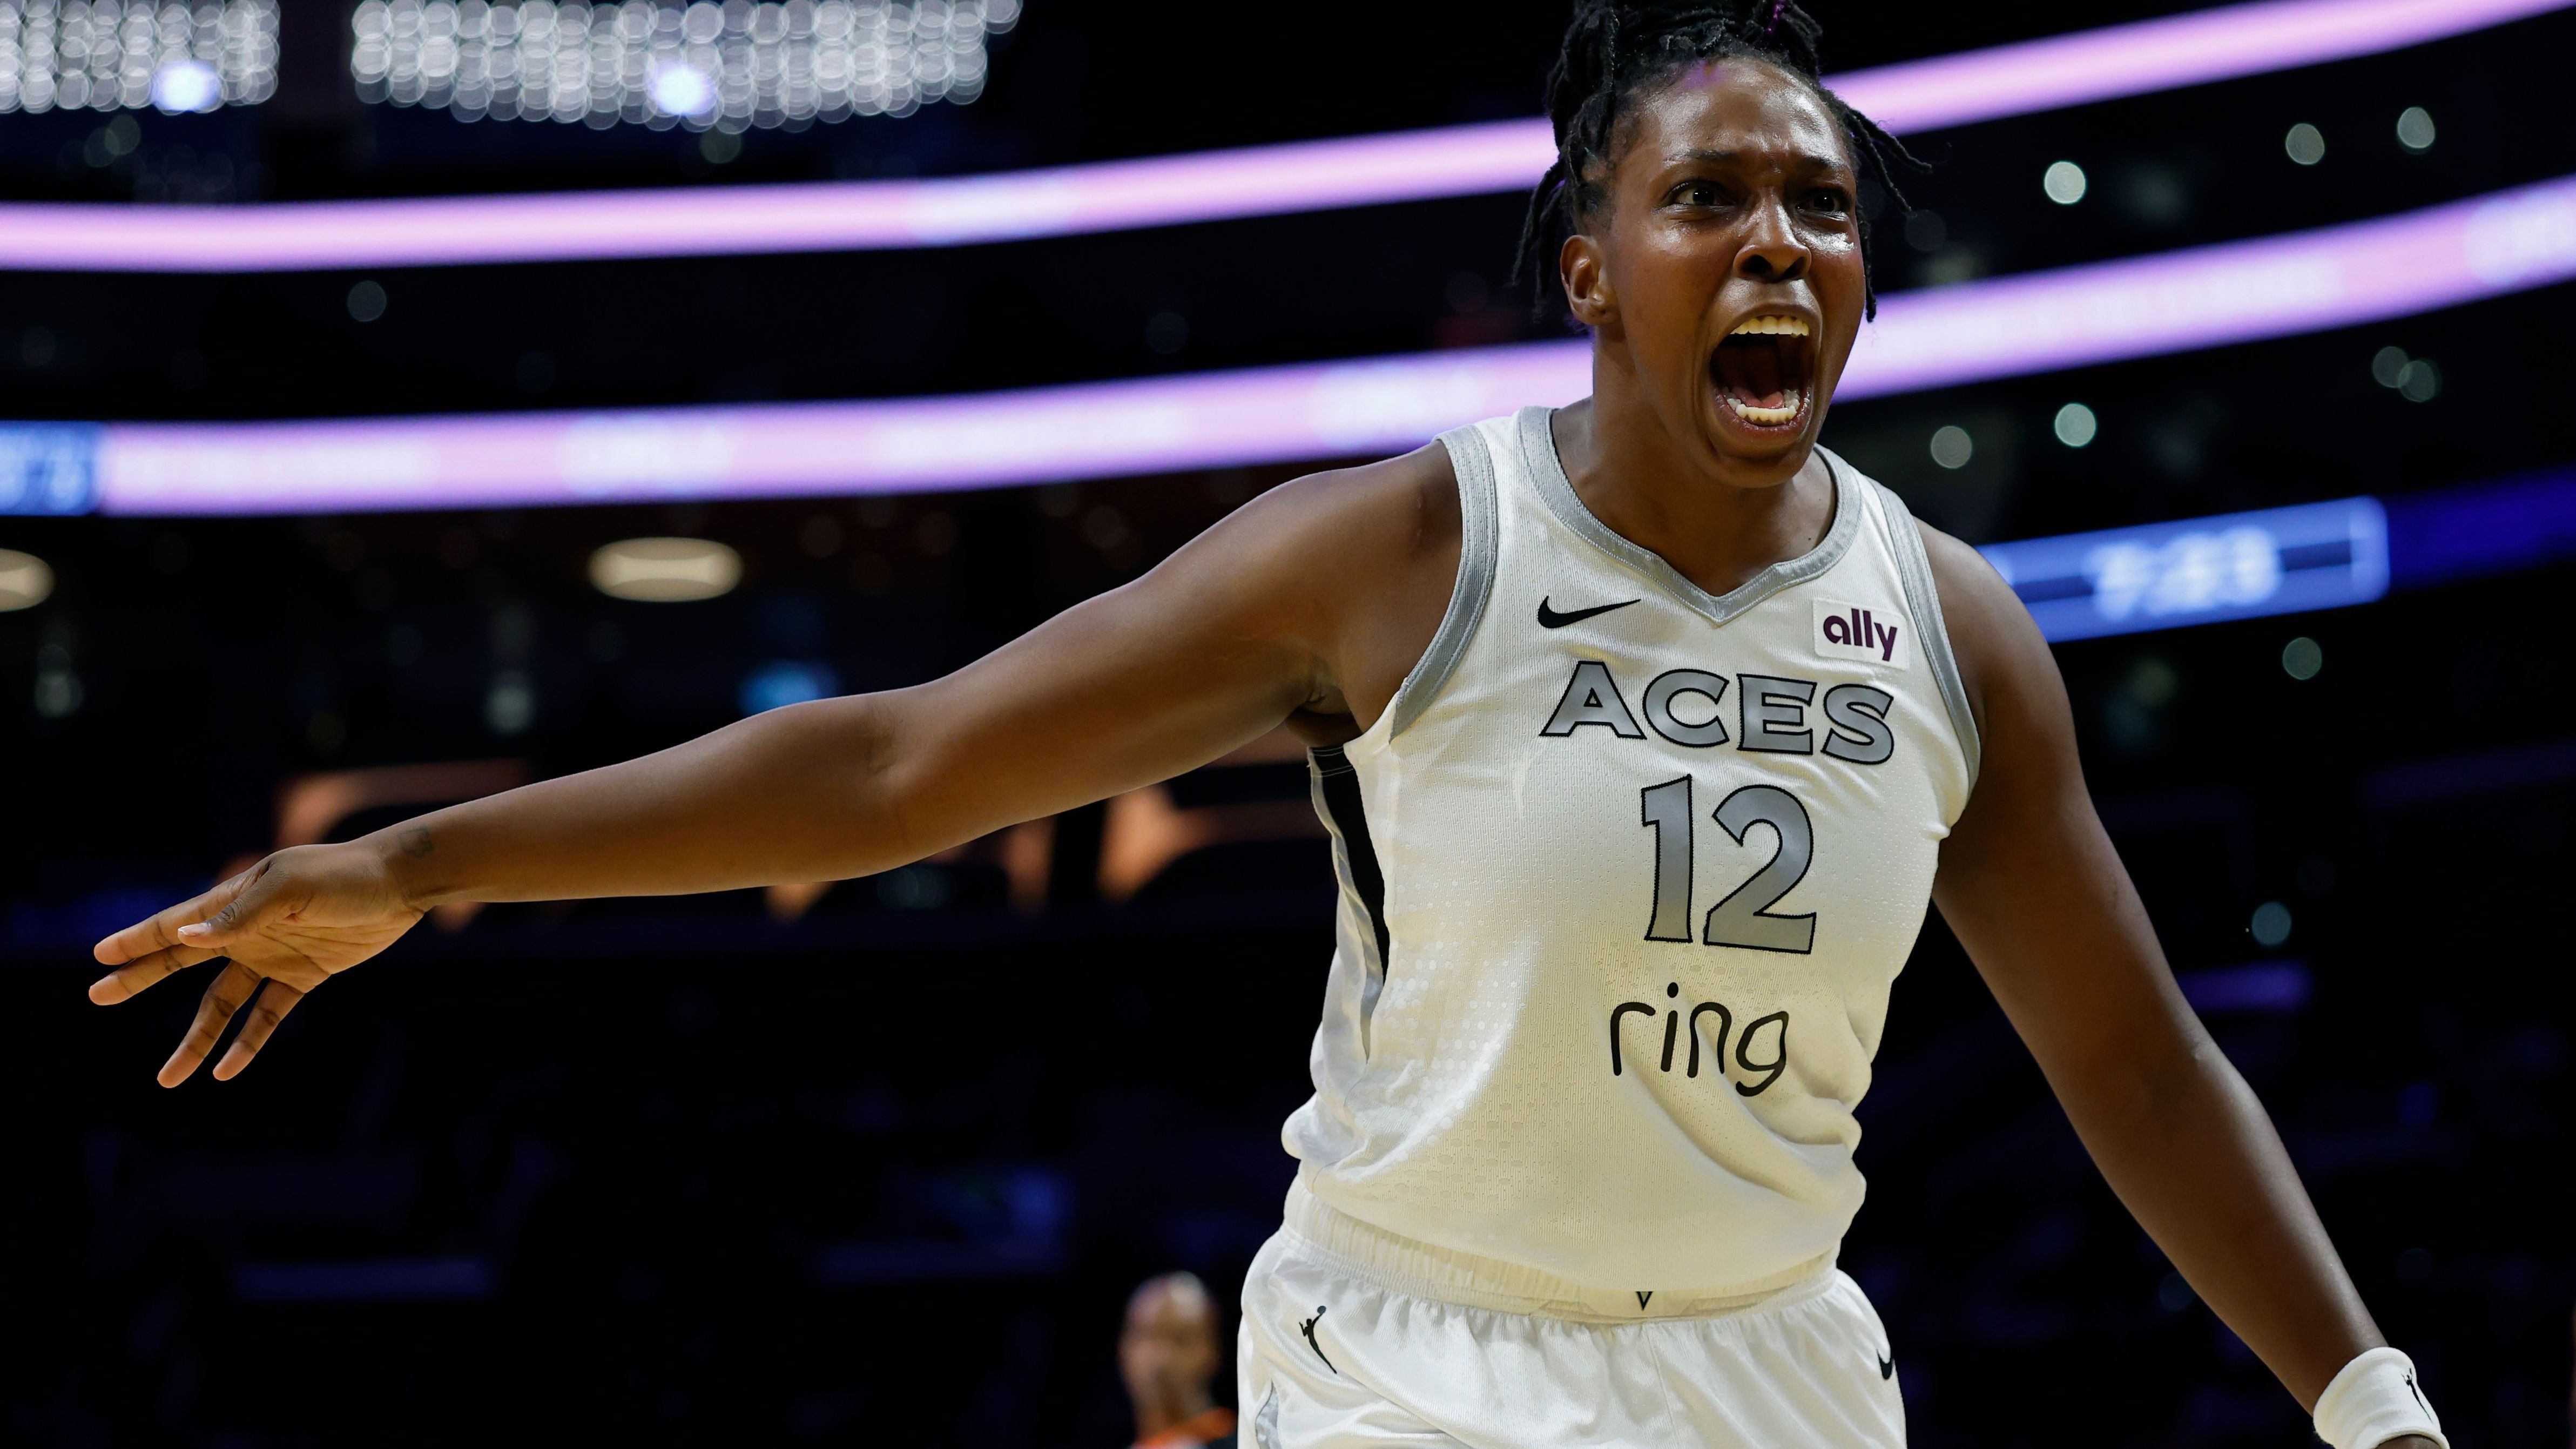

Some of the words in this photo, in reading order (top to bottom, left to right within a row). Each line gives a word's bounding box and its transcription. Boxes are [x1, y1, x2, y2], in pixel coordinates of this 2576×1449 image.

[1823, 609, 1897, 662] ally
[1541, 661, 1894, 764] ACES
[1641, 774, 1817, 954] 12
[1610, 982, 1790, 1097] ring
